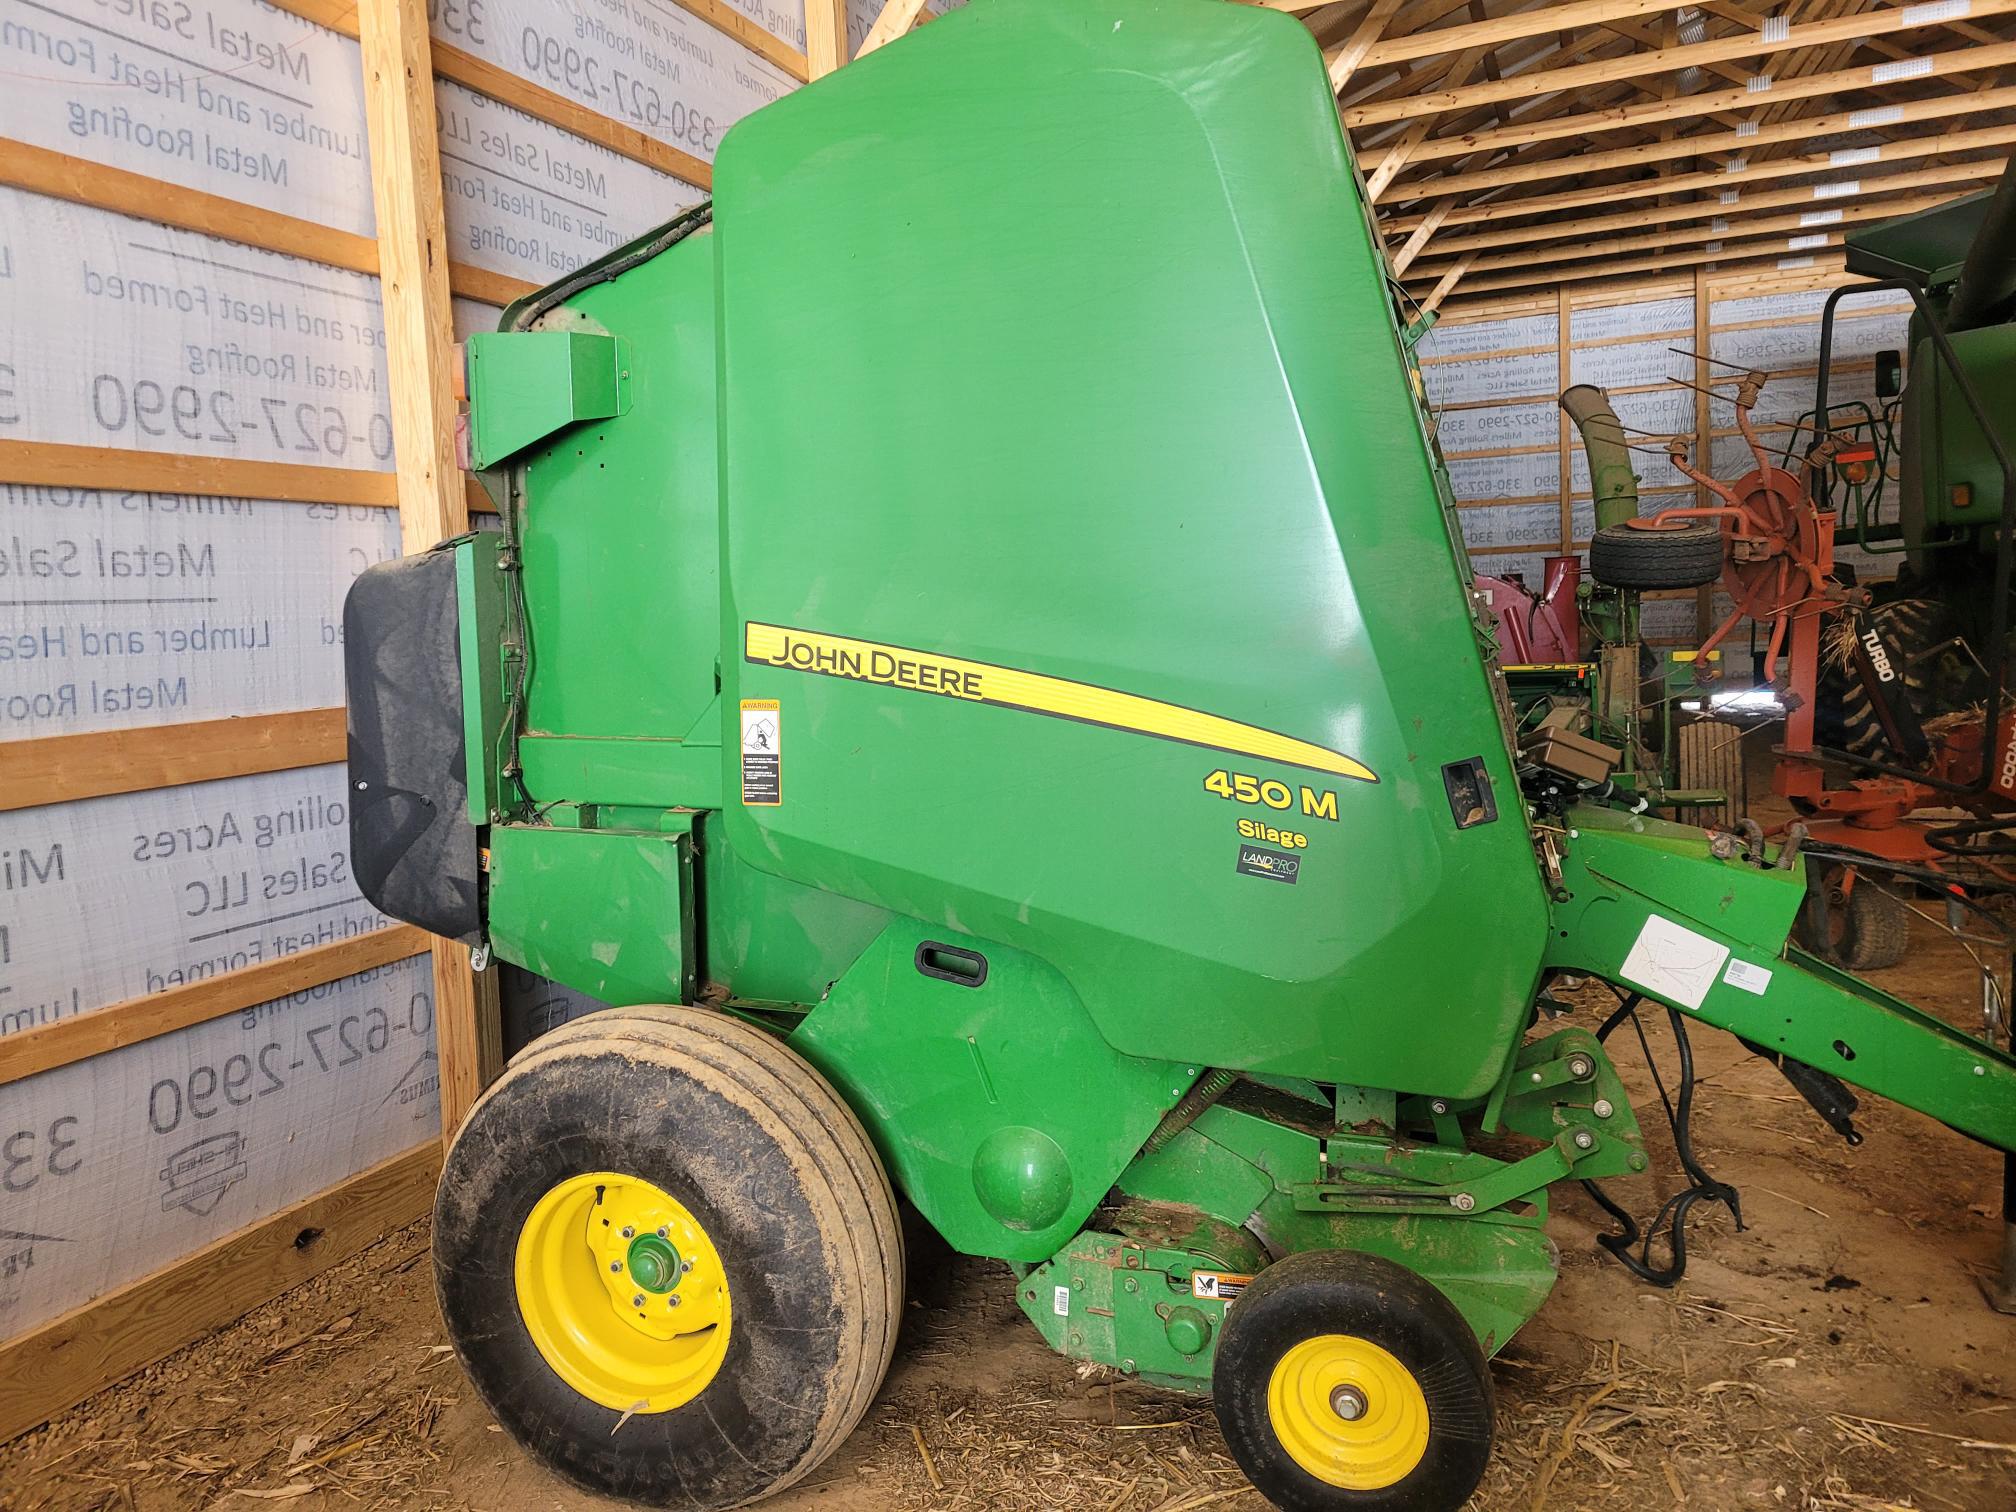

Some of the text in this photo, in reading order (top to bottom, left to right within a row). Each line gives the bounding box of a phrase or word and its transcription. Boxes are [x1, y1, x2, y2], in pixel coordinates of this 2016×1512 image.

[772, 636, 983, 697] JOHN DEERE
[1861, 628, 1895, 683] TURBO
[1204, 769, 1340, 822] 450 M
[1237, 818, 1308, 849] Silage
[1242, 851, 1298, 873] LANDPRO
